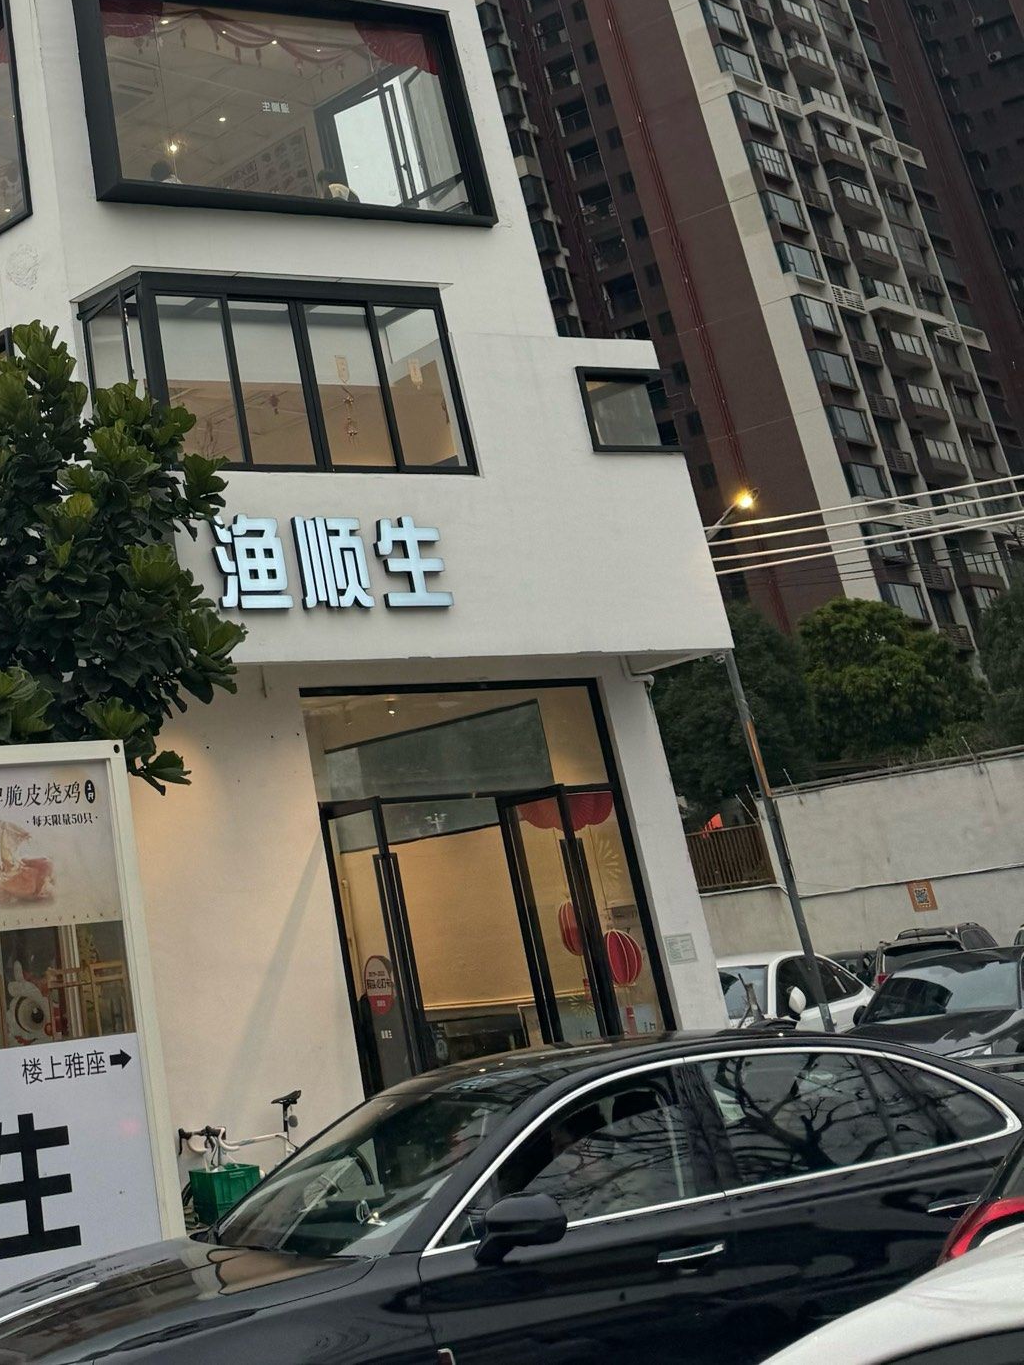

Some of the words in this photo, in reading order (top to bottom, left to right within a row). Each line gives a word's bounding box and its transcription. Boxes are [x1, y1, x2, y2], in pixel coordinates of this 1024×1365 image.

[212, 513, 454, 610] 渔顺生
[21, 1050, 107, 1084] 楼上雅座
